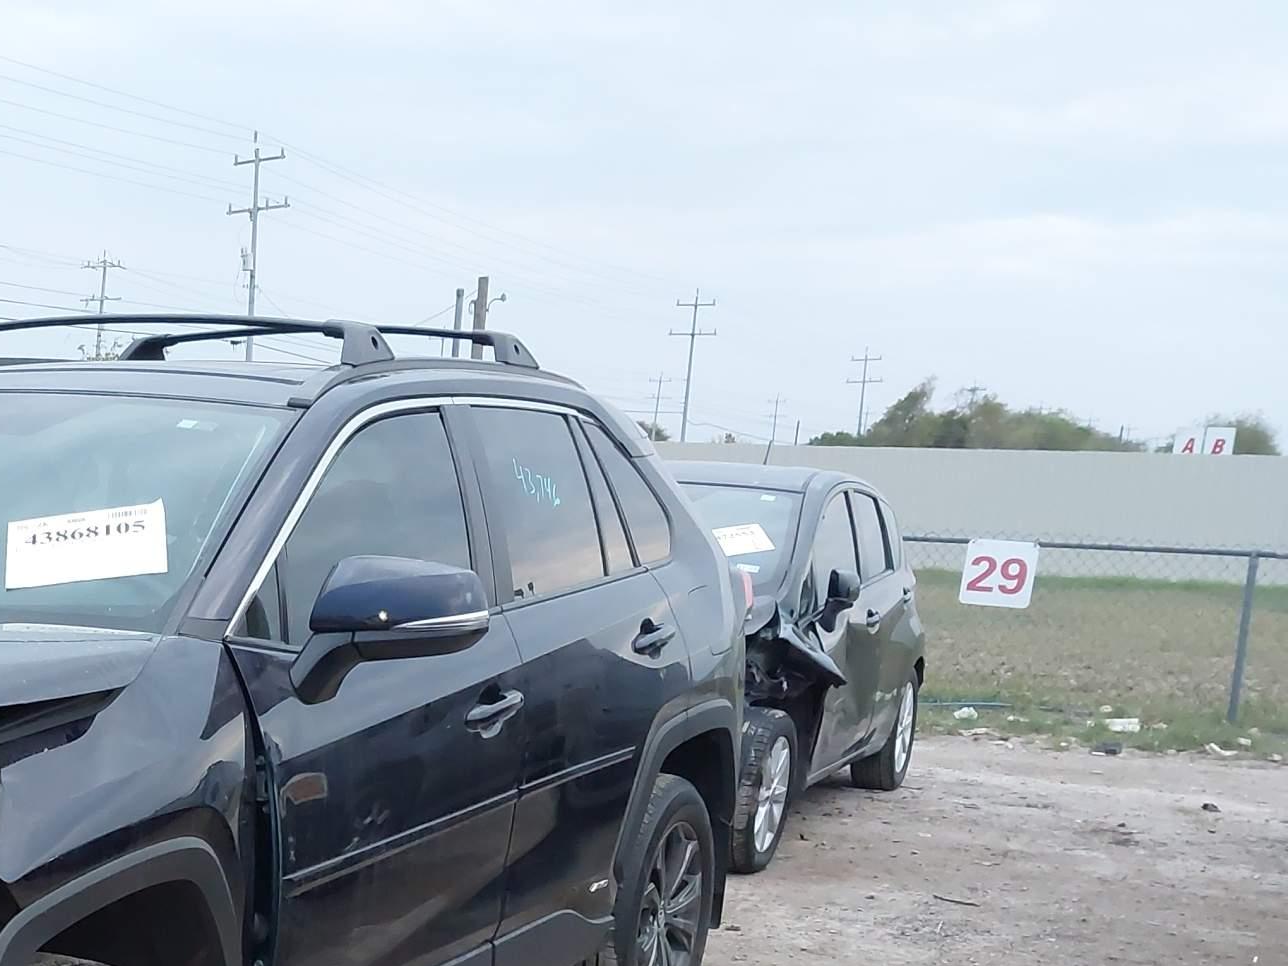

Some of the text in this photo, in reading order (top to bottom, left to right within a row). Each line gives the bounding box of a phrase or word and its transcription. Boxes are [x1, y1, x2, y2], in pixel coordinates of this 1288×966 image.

[1181, 438, 1195, 454] A
[1211, 439, 1226, 455] B
[24, 519, 146, 545] 43868105
[966, 555, 1028, 595] 29
